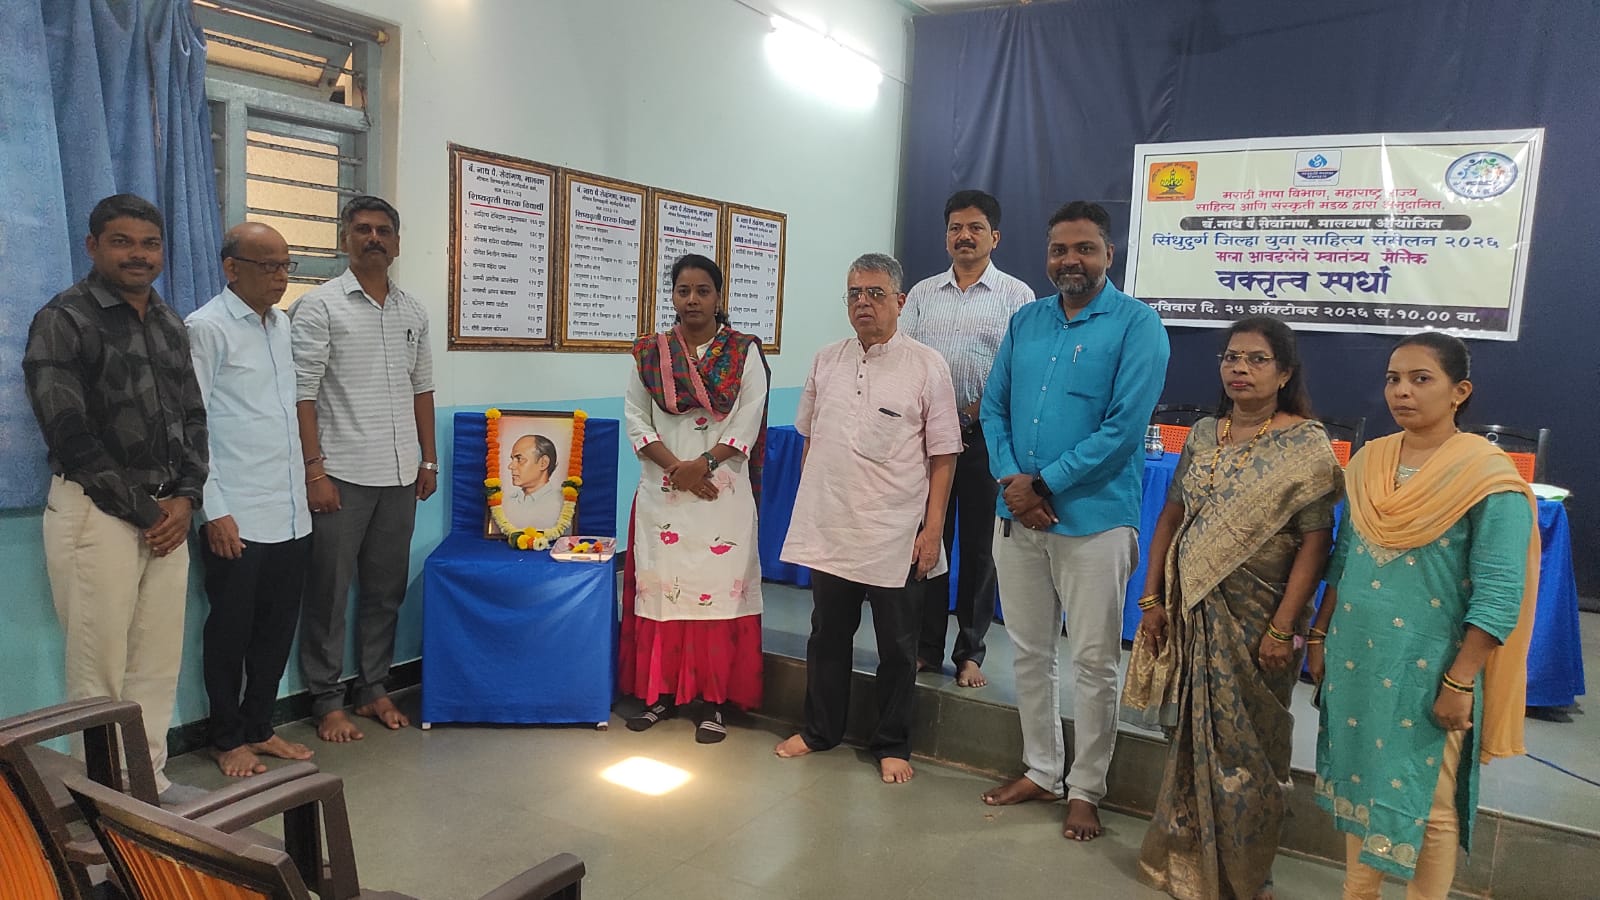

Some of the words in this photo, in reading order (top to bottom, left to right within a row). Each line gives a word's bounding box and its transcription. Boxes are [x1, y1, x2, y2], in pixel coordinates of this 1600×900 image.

[1222, 188, 1255, 200] मराठी
[1259, 188, 1284, 199] भाषा
[1334, 187, 1384, 201] महाराष्ट्र
[1196, 201, 1235, 212] साहित्य
[1240, 200, 1266, 211] आणि
[1272, 198, 1314, 214] संस्कृती
[1320, 198, 1348, 210] मंडळ
[1352, 199, 1377, 210] द्वारा
[1318, 218, 1370, 229] मालवण
[1375, 216, 1444, 230] आयोजित
[1152, 231, 1208, 250] सिंधुदुर्ग
[1215, 231, 1259, 246] जिल्हा
[1265, 234, 1296, 250] युवा
[1303, 231, 1364, 247] साहित्य
[1445, 236, 1499, 248] २०२६
[1250, 248, 1309, 263] आवडलेले
[1314, 249, 1370, 264] स्वातंत्र्य
[1215, 270, 1311, 298] वक्तृत्व
[1317, 266, 1392, 295] स्पर्धा
[1149, 301, 1196, 312] रविवार
[1201, 301, 1218, 314] दि.
[1225, 304, 1244, 314] २५
[1248, 302, 1320, 316] ऑक्टोबर
[1324, 306, 1369, 318] २०२६
[1456, 312, 1481, 323] वा.
